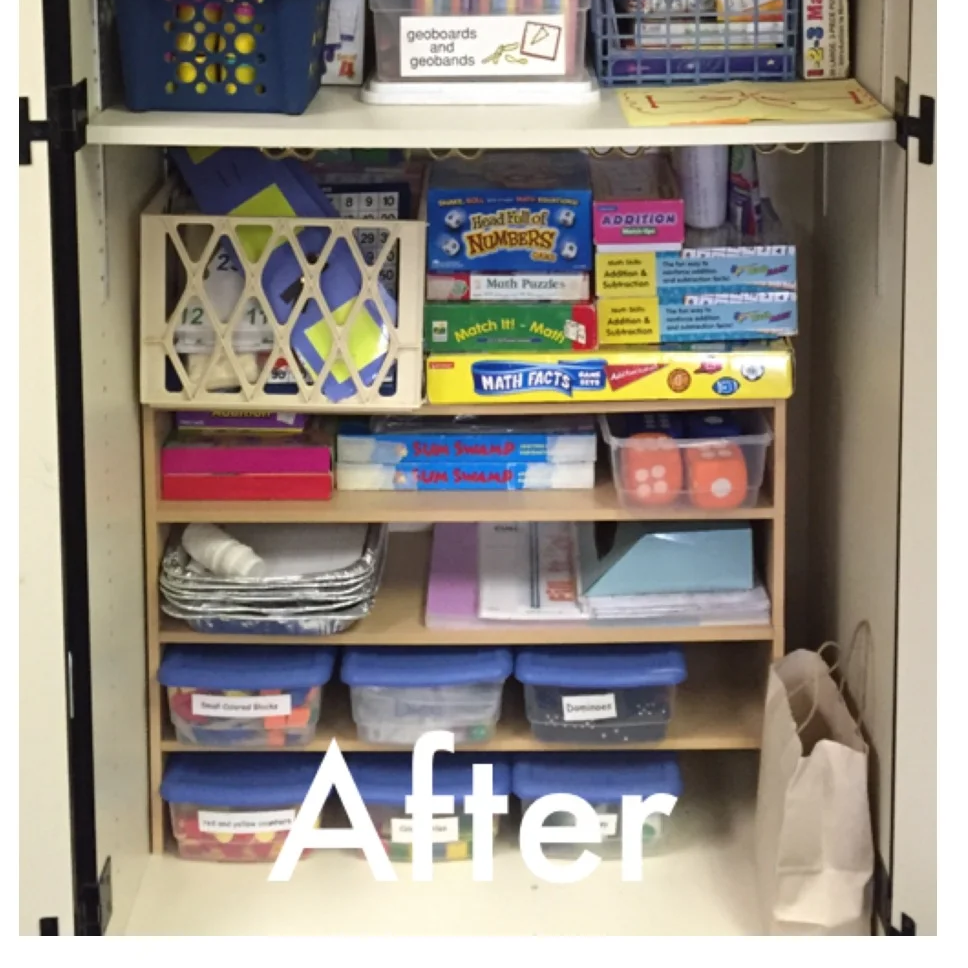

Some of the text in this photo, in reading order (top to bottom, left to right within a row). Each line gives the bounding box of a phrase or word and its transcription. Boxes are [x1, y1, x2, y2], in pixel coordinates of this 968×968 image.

[406, 28, 478, 42] geoboards
[430, 42, 455, 54] and
[409, 55, 475, 69] geobands
[345, 195, 395, 208] 8 9 10
[471, 211, 505, 231] Head
[532, 209, 549, 225] of
[602, 214, 676, 226] ADDITION
[604, 268, 647, 278] Addition &
[486, 277, 566, 290] Math Puzzles
[602, 280, 649, 289] Subtraction
[608, 316, 651, 325] Addition &
[454, 319, 499, 343] Match
[529, 321, 565, 344] Math
[605, 327, 653, 336] Subtraction
[482, 368, 571, 391] MATH FACTS
[454, 440, 515, 456] SWAMP
[452, 468, 514, 483] SWAMP
